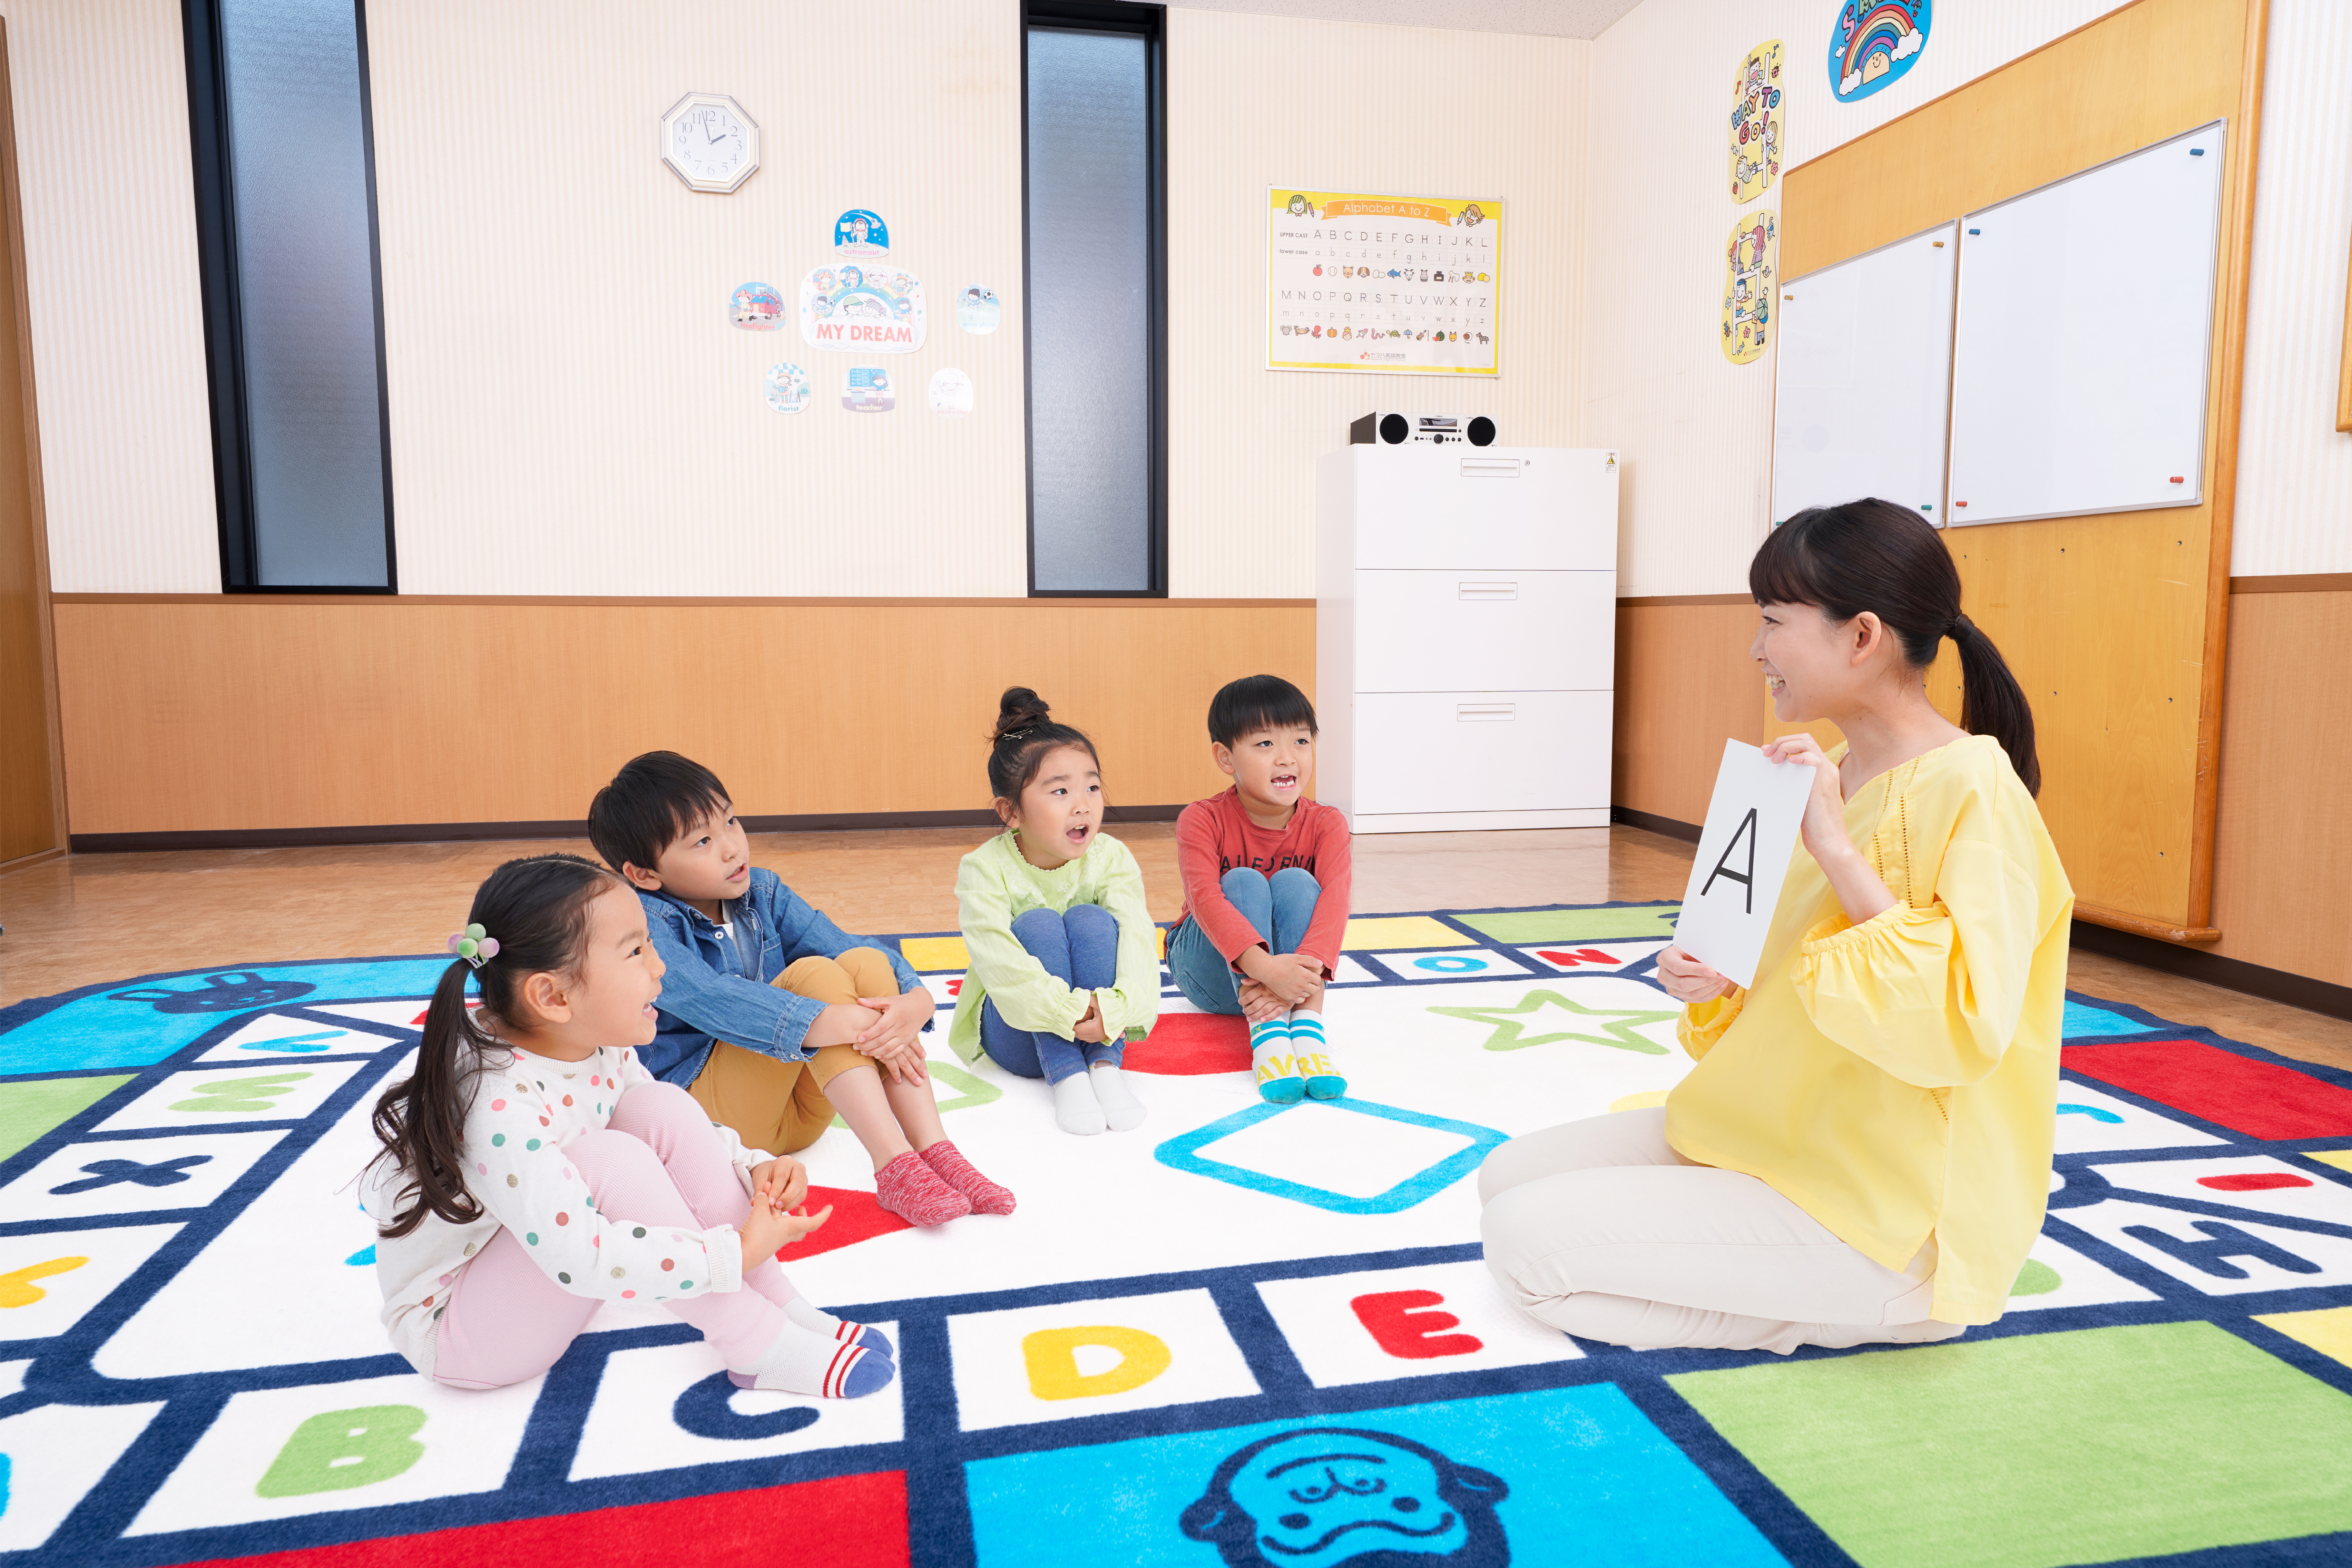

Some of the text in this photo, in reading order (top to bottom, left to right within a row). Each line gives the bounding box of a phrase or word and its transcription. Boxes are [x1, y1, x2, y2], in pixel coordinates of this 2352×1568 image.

[1731, 86, 1780, 130] WAY TO
[693, 113, 701, 124] 11
[705, 111, 715, 122] 12
[722, 116, 725, 126] 1
[682, 122, 692, 133] 10
[730, 126, 737, 136] 2
[1739, 111, 1769, 145] GO!
[679, 136, 686, 145] 9
[735, 140, 742, 151] 3
[684, 149, 690, 160] 8
[730, 154, 737, 164] 4
[695, 160, 701, 170] 7
[708, 165, 714, 175] 6
[721, 163, 728, 173] 5
[1343, 203, 1429, 217] Alphabet A to Z
[1314, 230, 1321, 238] A
[1330, 230, 1337, 239] B
[1345, 231, 1352, 240] C
[1361, 232, 1368, 240] D
[1377, 233, 1382, 241] E
[1392, 234, 1398, 242] F
[1405, 234, 1413, 243] G
[1422, 235, 1427, 243] H
[1439, 236, 1441, 244] I
[1452, 237, 1457, 245] J
[1466, 238, 1472, 246] K
[1482, 238, 1487, 247] L
[1330, 247, 1335, 256] b
[1362, 249, 1366, 257] d
[1393, 250, 1397, 259] f
[1407, 255, 1411, 263] g
[1423, 252, 1426, 260] h
[1452, 255, 1456, 265] j
[1467, 254, 1471, 262] k
[1282, 290, 1290, 299] M
[1299, 291, 1305, 299] N
[1313, 292, 1321, 300] O
[1330, 292, 1336, 301] P
[1344, 293, 1352, 301] Q
[1361, 294, 1367, 302] R
[1376, 294, 1381, 302] S
[1390, 295, 1398, 303] T
[1420, 296, 1428, 304] V
[1433, 296, 1444, 305] W
[1450, 297, 1457, 306] X
[1466, 298, 1471, 306] Y
[1480, 298, 1486, 307] Z
[1330, 313, 1334, 321] p
[1345, 314, 1349, 322] q
[740, 322, 775, 331] firefighter
[817, 324, 912, 343] MY DREAM
[1700, 808, 1757, 914] A
[1413, 956, 1488, 973] O
[49, 1155, 214, 1195] X
[2121, 1220, 2323, 1279] H
[1350, 1289, 1484, 1359] E
[1022, 1325, 1172, 1401] D
[255, 1404, 428, 1498] B
